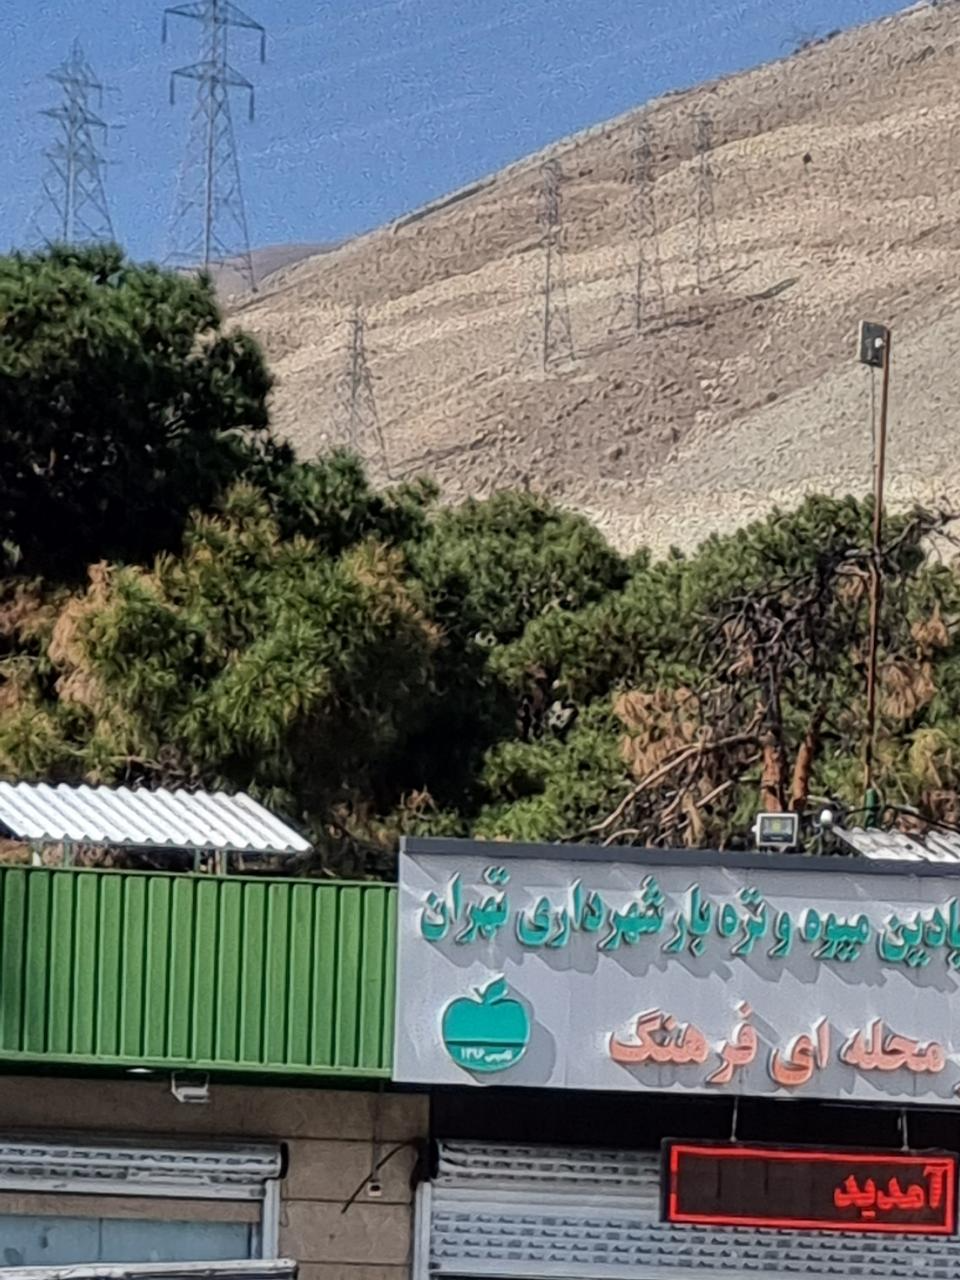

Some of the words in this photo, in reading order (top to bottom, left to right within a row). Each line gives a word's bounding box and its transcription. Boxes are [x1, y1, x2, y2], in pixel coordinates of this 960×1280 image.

[418, 865, 511, 945] تهران
[515, 873, 668, 950] شهرداری
[662, 882, 712, 957] بار
[719, 886, 769, 958] تره
[769, 908, 793, 958] و
[800, 908, 871, 962] میوه
[607, 999, 760, 1085] فرهنگ
[769, 1015, 831, 1087] ای
[839, 1016, 946, 1072] محله
[832, 1165, 948, 1219] آمدید
